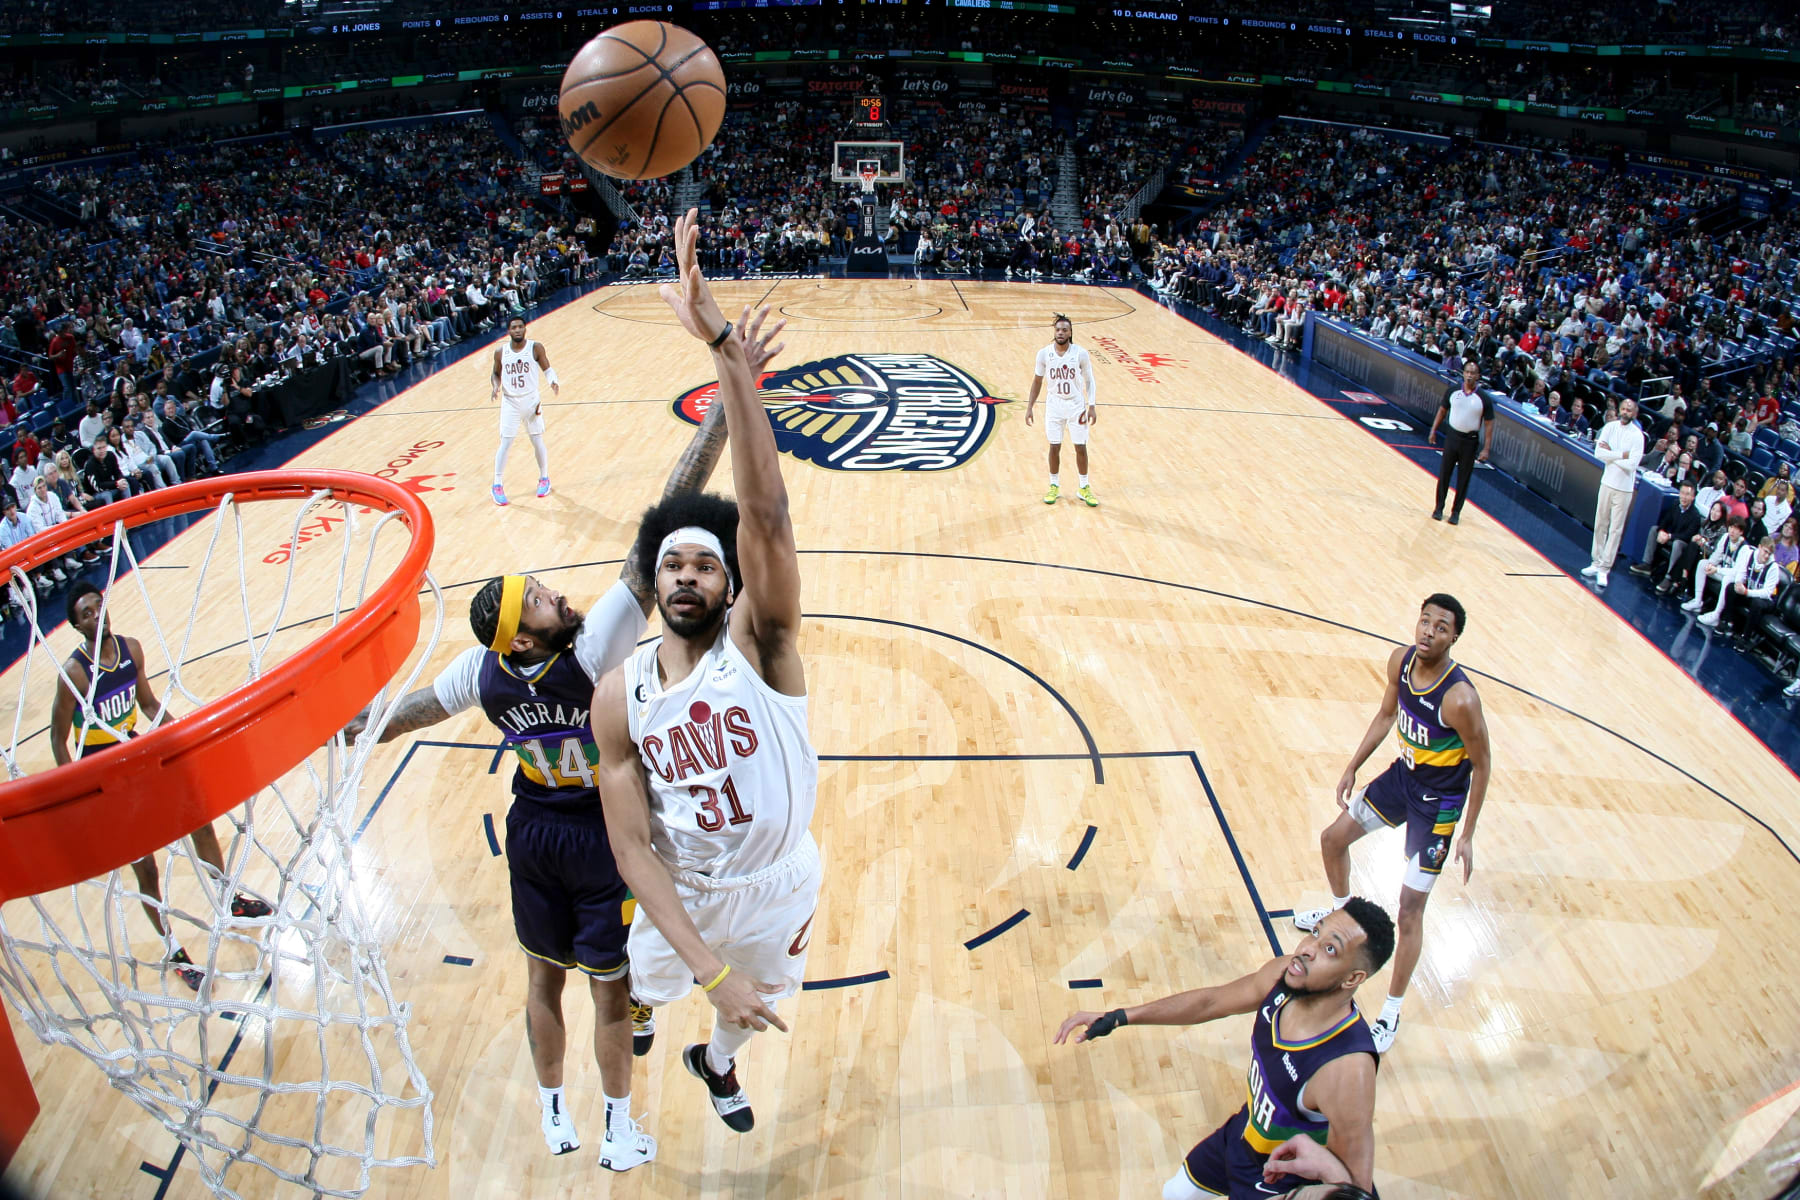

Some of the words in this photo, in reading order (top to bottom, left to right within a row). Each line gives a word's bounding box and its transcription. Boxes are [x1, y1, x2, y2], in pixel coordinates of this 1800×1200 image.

[628, 5, 663, 14] BLOCKS
[667, 5, 673, 13] 0
[954, 0, 991, 8] CAVALIERS
[520, 12, 553, 21] ASSISTS
[556, 11, 563, 19] 0
[576, 8, 609, 17] STEALS
[612, 7, 618, 15] 0
[1112, 9, 1122, 17] 10
[1124, 10, 1134, 18] D.
[1135, 11, 1179, 21] GARLAND
[402, 20, 431, 29] POINTS
[435, 19, 441, 28] 0
[454, 15, 500, 25] REBOUNDS
[503, 14, 509, 22] 0
[1188, 15, 1219, 25] POINTS
[1223, 18, 1229, 26] 0
[1241, 19, 1287, 30] REBOUNDS
[1290, 23, 1296, 31] 0
[332, 26, 338, 34] 5
[341, 25, 351, 33] H.
[352, 22, 381, 32] JONES
[1307, 25, 1343, 35] ASSISTS
[1345, 28, 1351, 36] 0
[1363, 29, 1394, 39] STEALS
[1397, 31, 1403, 40] 0
[1413, 32, 1447, 44] BLOCKS
[1451, 36, 1457, 45] 0
[727, 81, 741, 94] t's
[743, 81, 760, 94] Go
[808, 80, 864, 92] SEATGEEK
[903, 79, 931, 92] Let's
[932, 80, 949, 92] Go
[522, 95, 548, 108] Let's
[861, 98, 882, 107] 10:56
[1088, 89, 1115, 103] Let's
[1116, 90, 1133, 103] Go
[869, 106, 881, 121] 8
[23, 151, 68, 165] BETRIVERS
[1647, 155, 1690, 168] BETRIVERS
[1713, 166, 1761, 180] BETRIVERS
[854, 246, 883, 255] KIA
[505, 361, 530, 375] CAVS
[852, 353, 961, 384] NEW
[1050, 367, 1076, 380] CAVS
[511, 375, 525, 389] 45
[1057, 381, 1071, 395] 10
[840, 386, 978, 470] ORLEANS
[1490, 424, 1528, 474] istory
[712, 667, 737, 682] CLIFFS
[500, 702, 589, 735] INGRAM
[1398, 705, 1430, 747] OLA
[642, 705, 759, 783] CAVS
[522, 737, 596, 790] 14
[688, 774, 753, 833] 31
[1249, 1054, 1276, 1132] OLA
